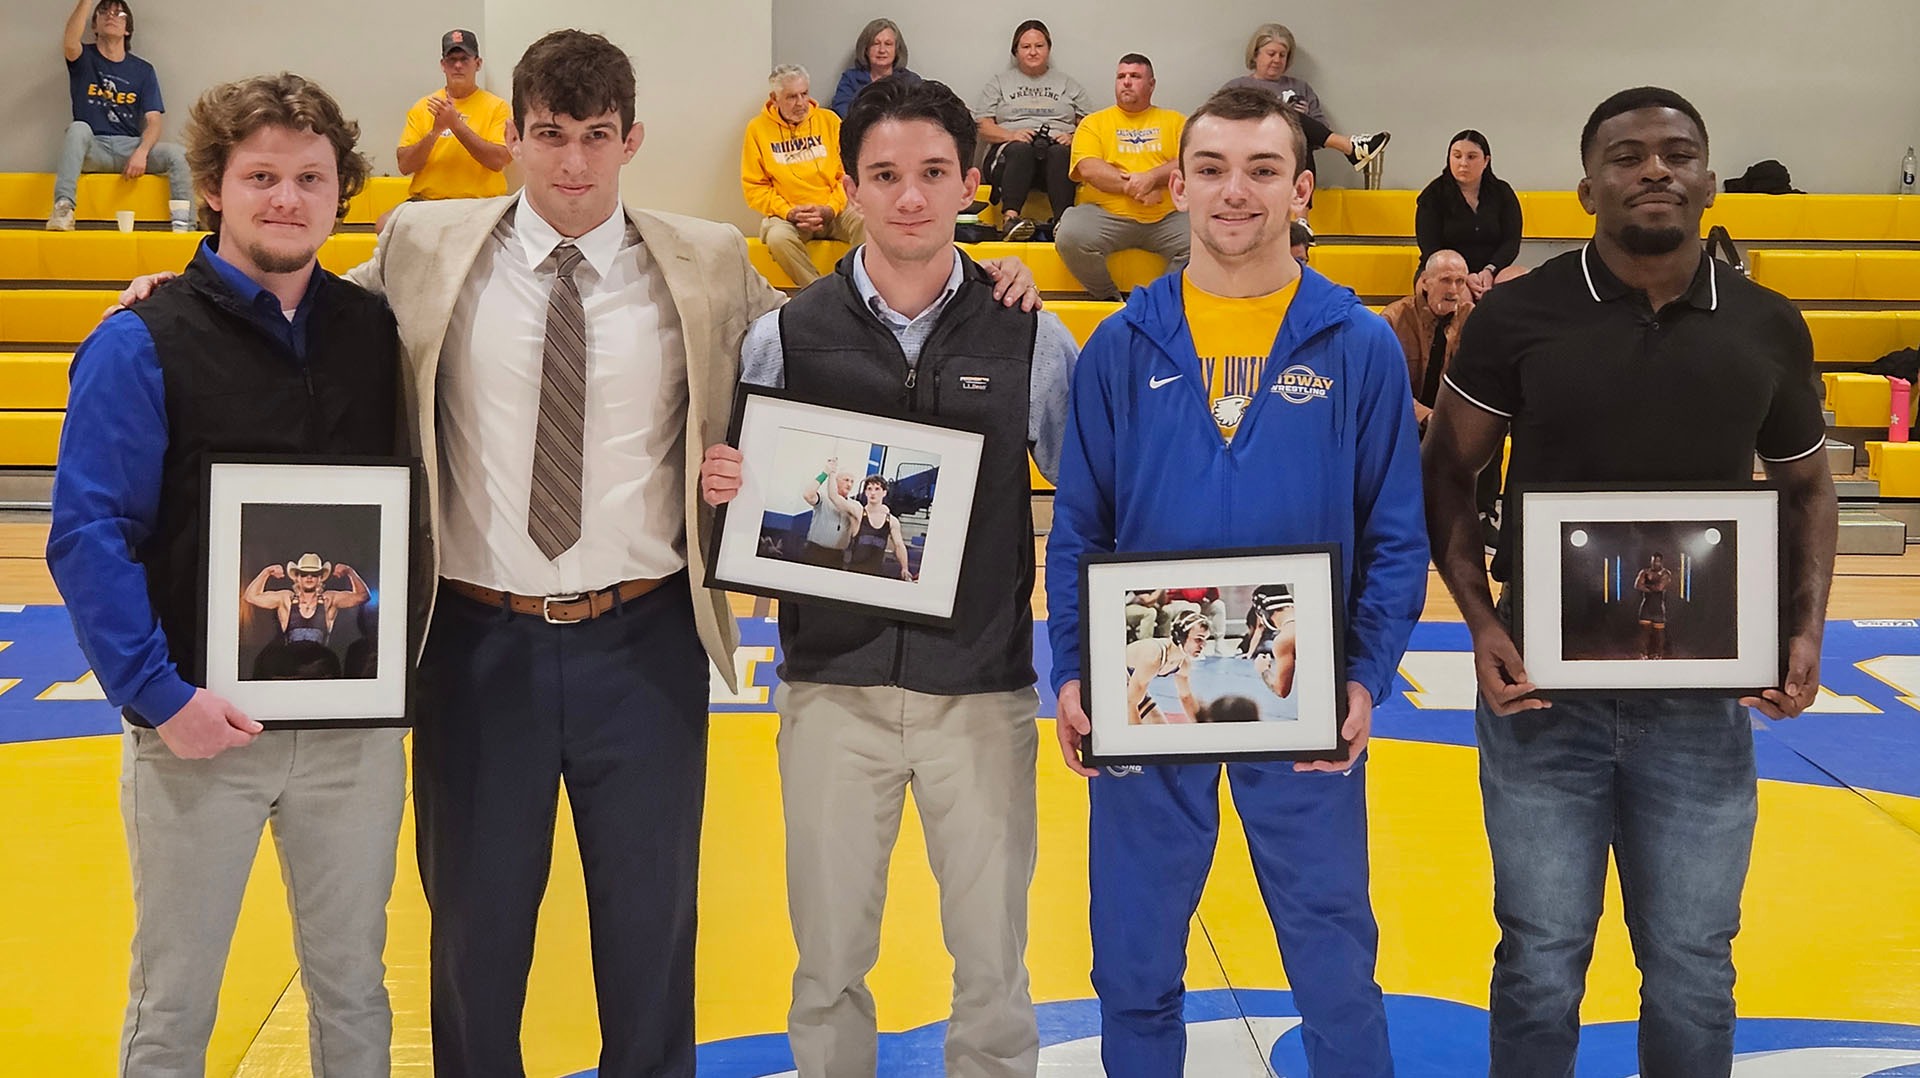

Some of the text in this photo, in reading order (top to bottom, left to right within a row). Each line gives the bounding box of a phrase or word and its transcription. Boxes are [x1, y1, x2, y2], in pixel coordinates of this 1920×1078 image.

[87, 83, 137, 104] EAES
[771, 135, 822, 153] MIDWAY
[1270, 384, 1326, 396] WRESTLING
[1276, 374, 1334, 390] IDWAY
